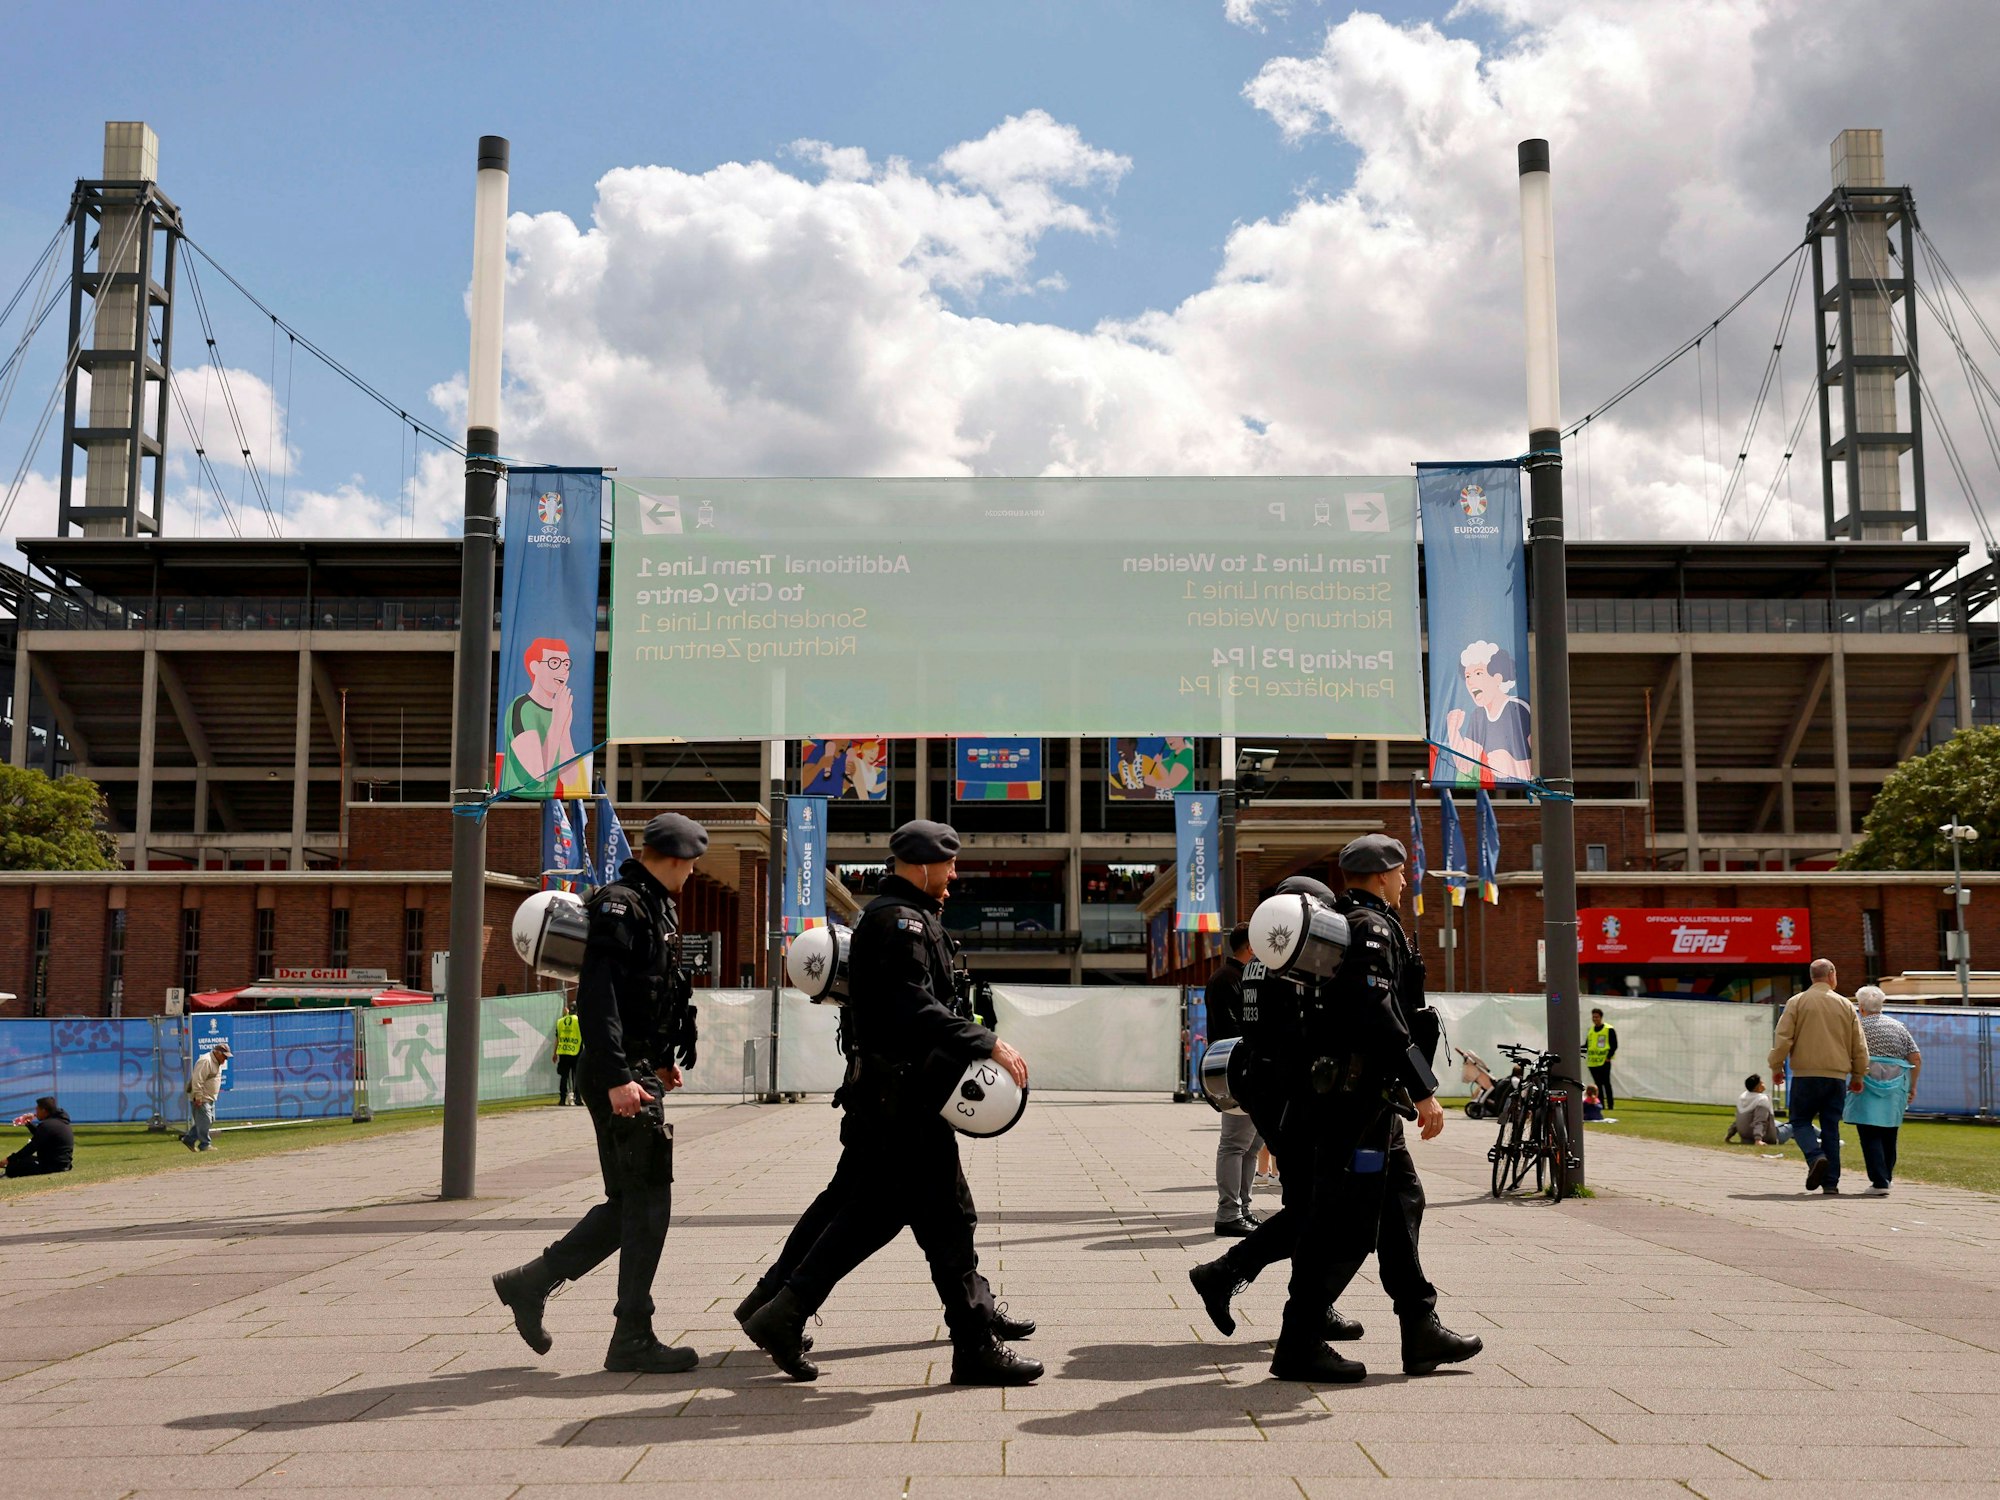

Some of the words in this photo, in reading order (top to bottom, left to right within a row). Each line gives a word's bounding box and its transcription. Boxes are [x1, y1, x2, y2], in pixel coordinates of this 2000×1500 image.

[1466, 517, 1485, 526] UEFA
[541, 525, 559, 535] UEFA
[1453, 526, 1499, 534] EURO2024
[527, 535, 571, 545] EURO2024
[802, 842, 813, 906] COLOGNE
[1195, 837, 1206, 902] COLOGNE
[279, 968, 307, 979] Der
[311, 968, 348, 979] Grill
[956, 1101, 975, 1117] 3
